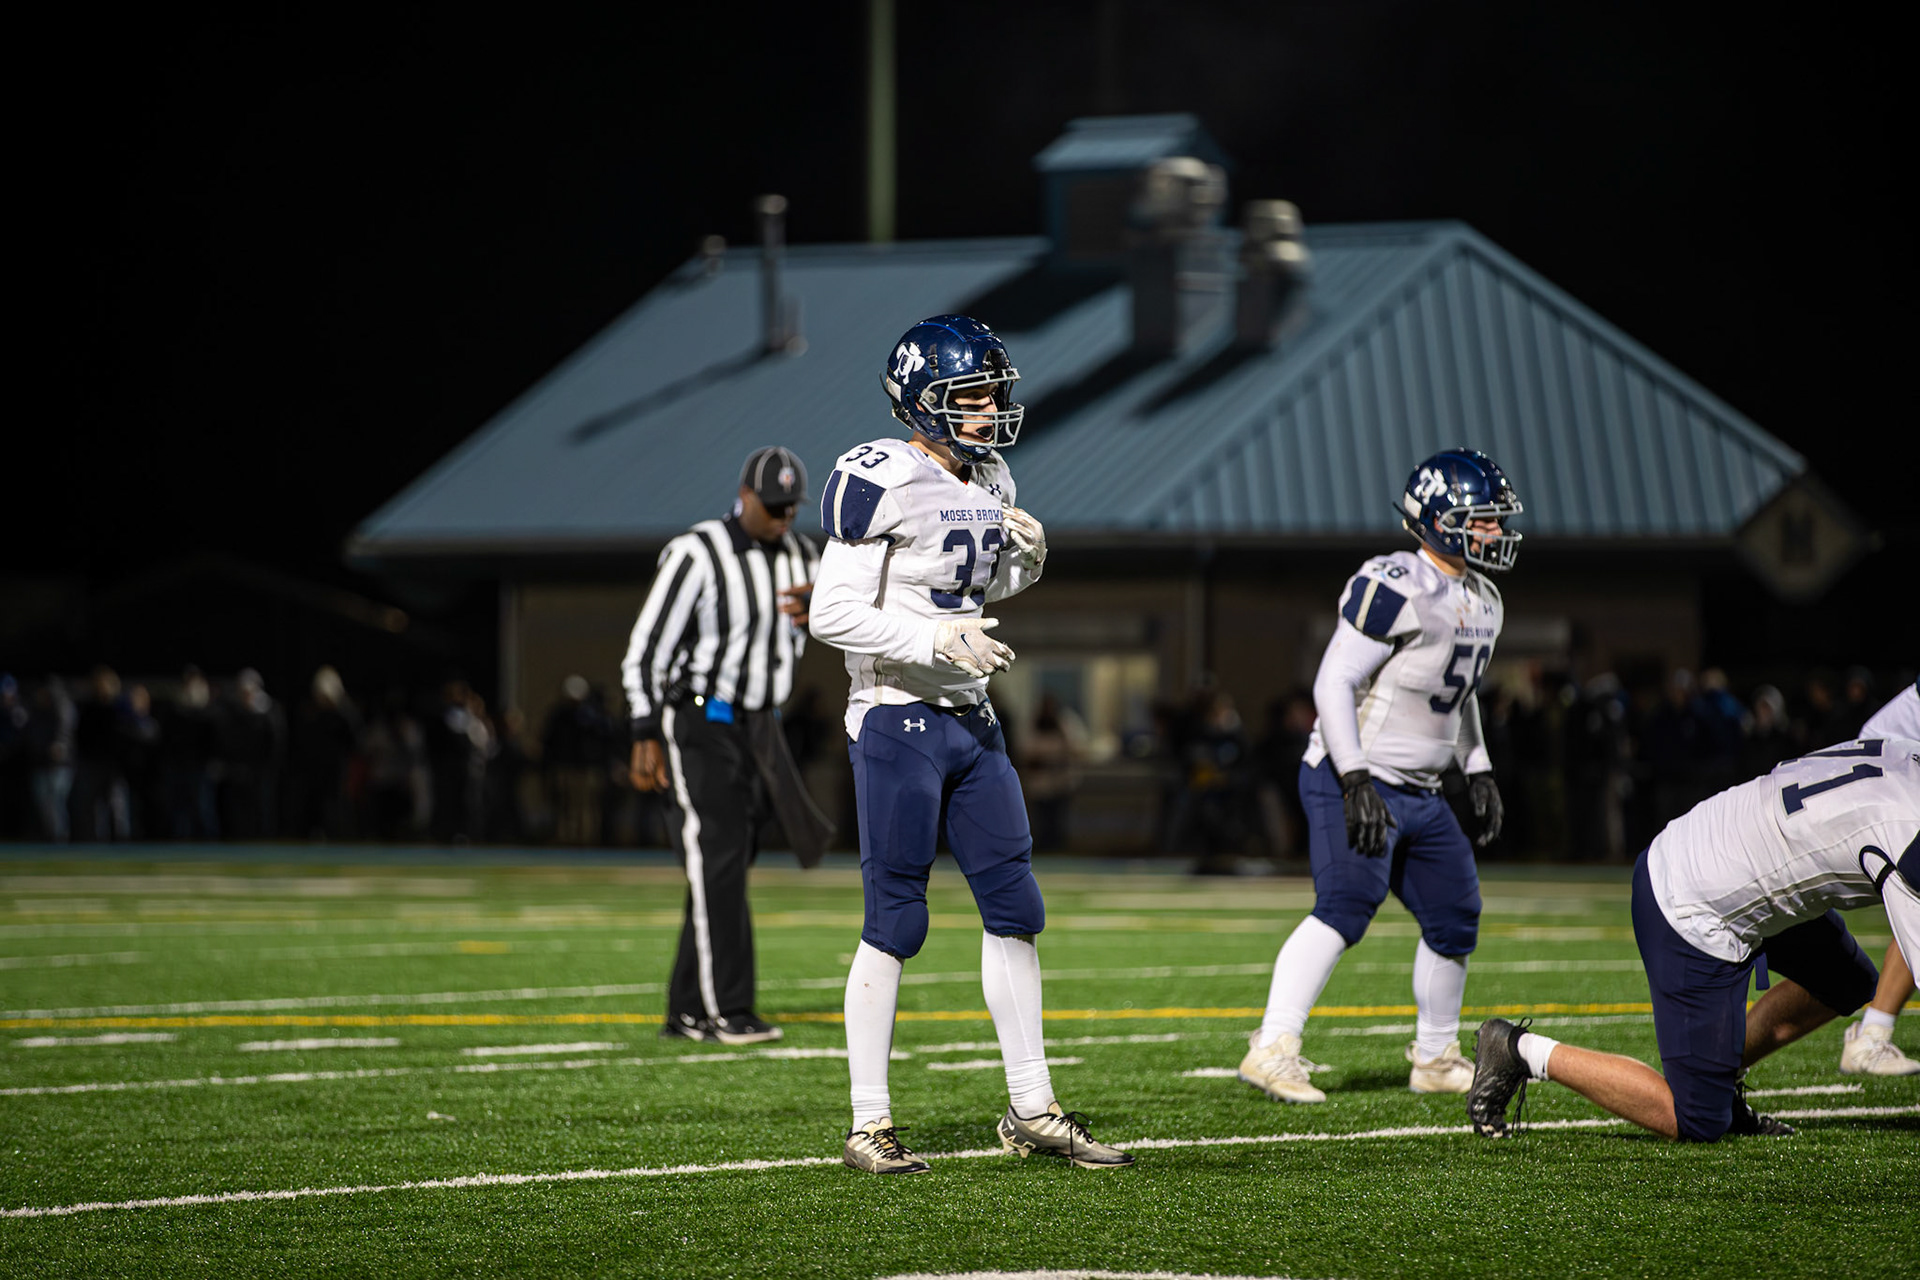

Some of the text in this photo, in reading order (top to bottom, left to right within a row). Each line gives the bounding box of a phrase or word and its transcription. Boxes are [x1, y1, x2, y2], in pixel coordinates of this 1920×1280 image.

[845, 445, 889, 469] 33
[940, 509, 974, 522] MOSES
[929, 527, 1005, 609] 33
[1779, 738, 1885, 817] 71
